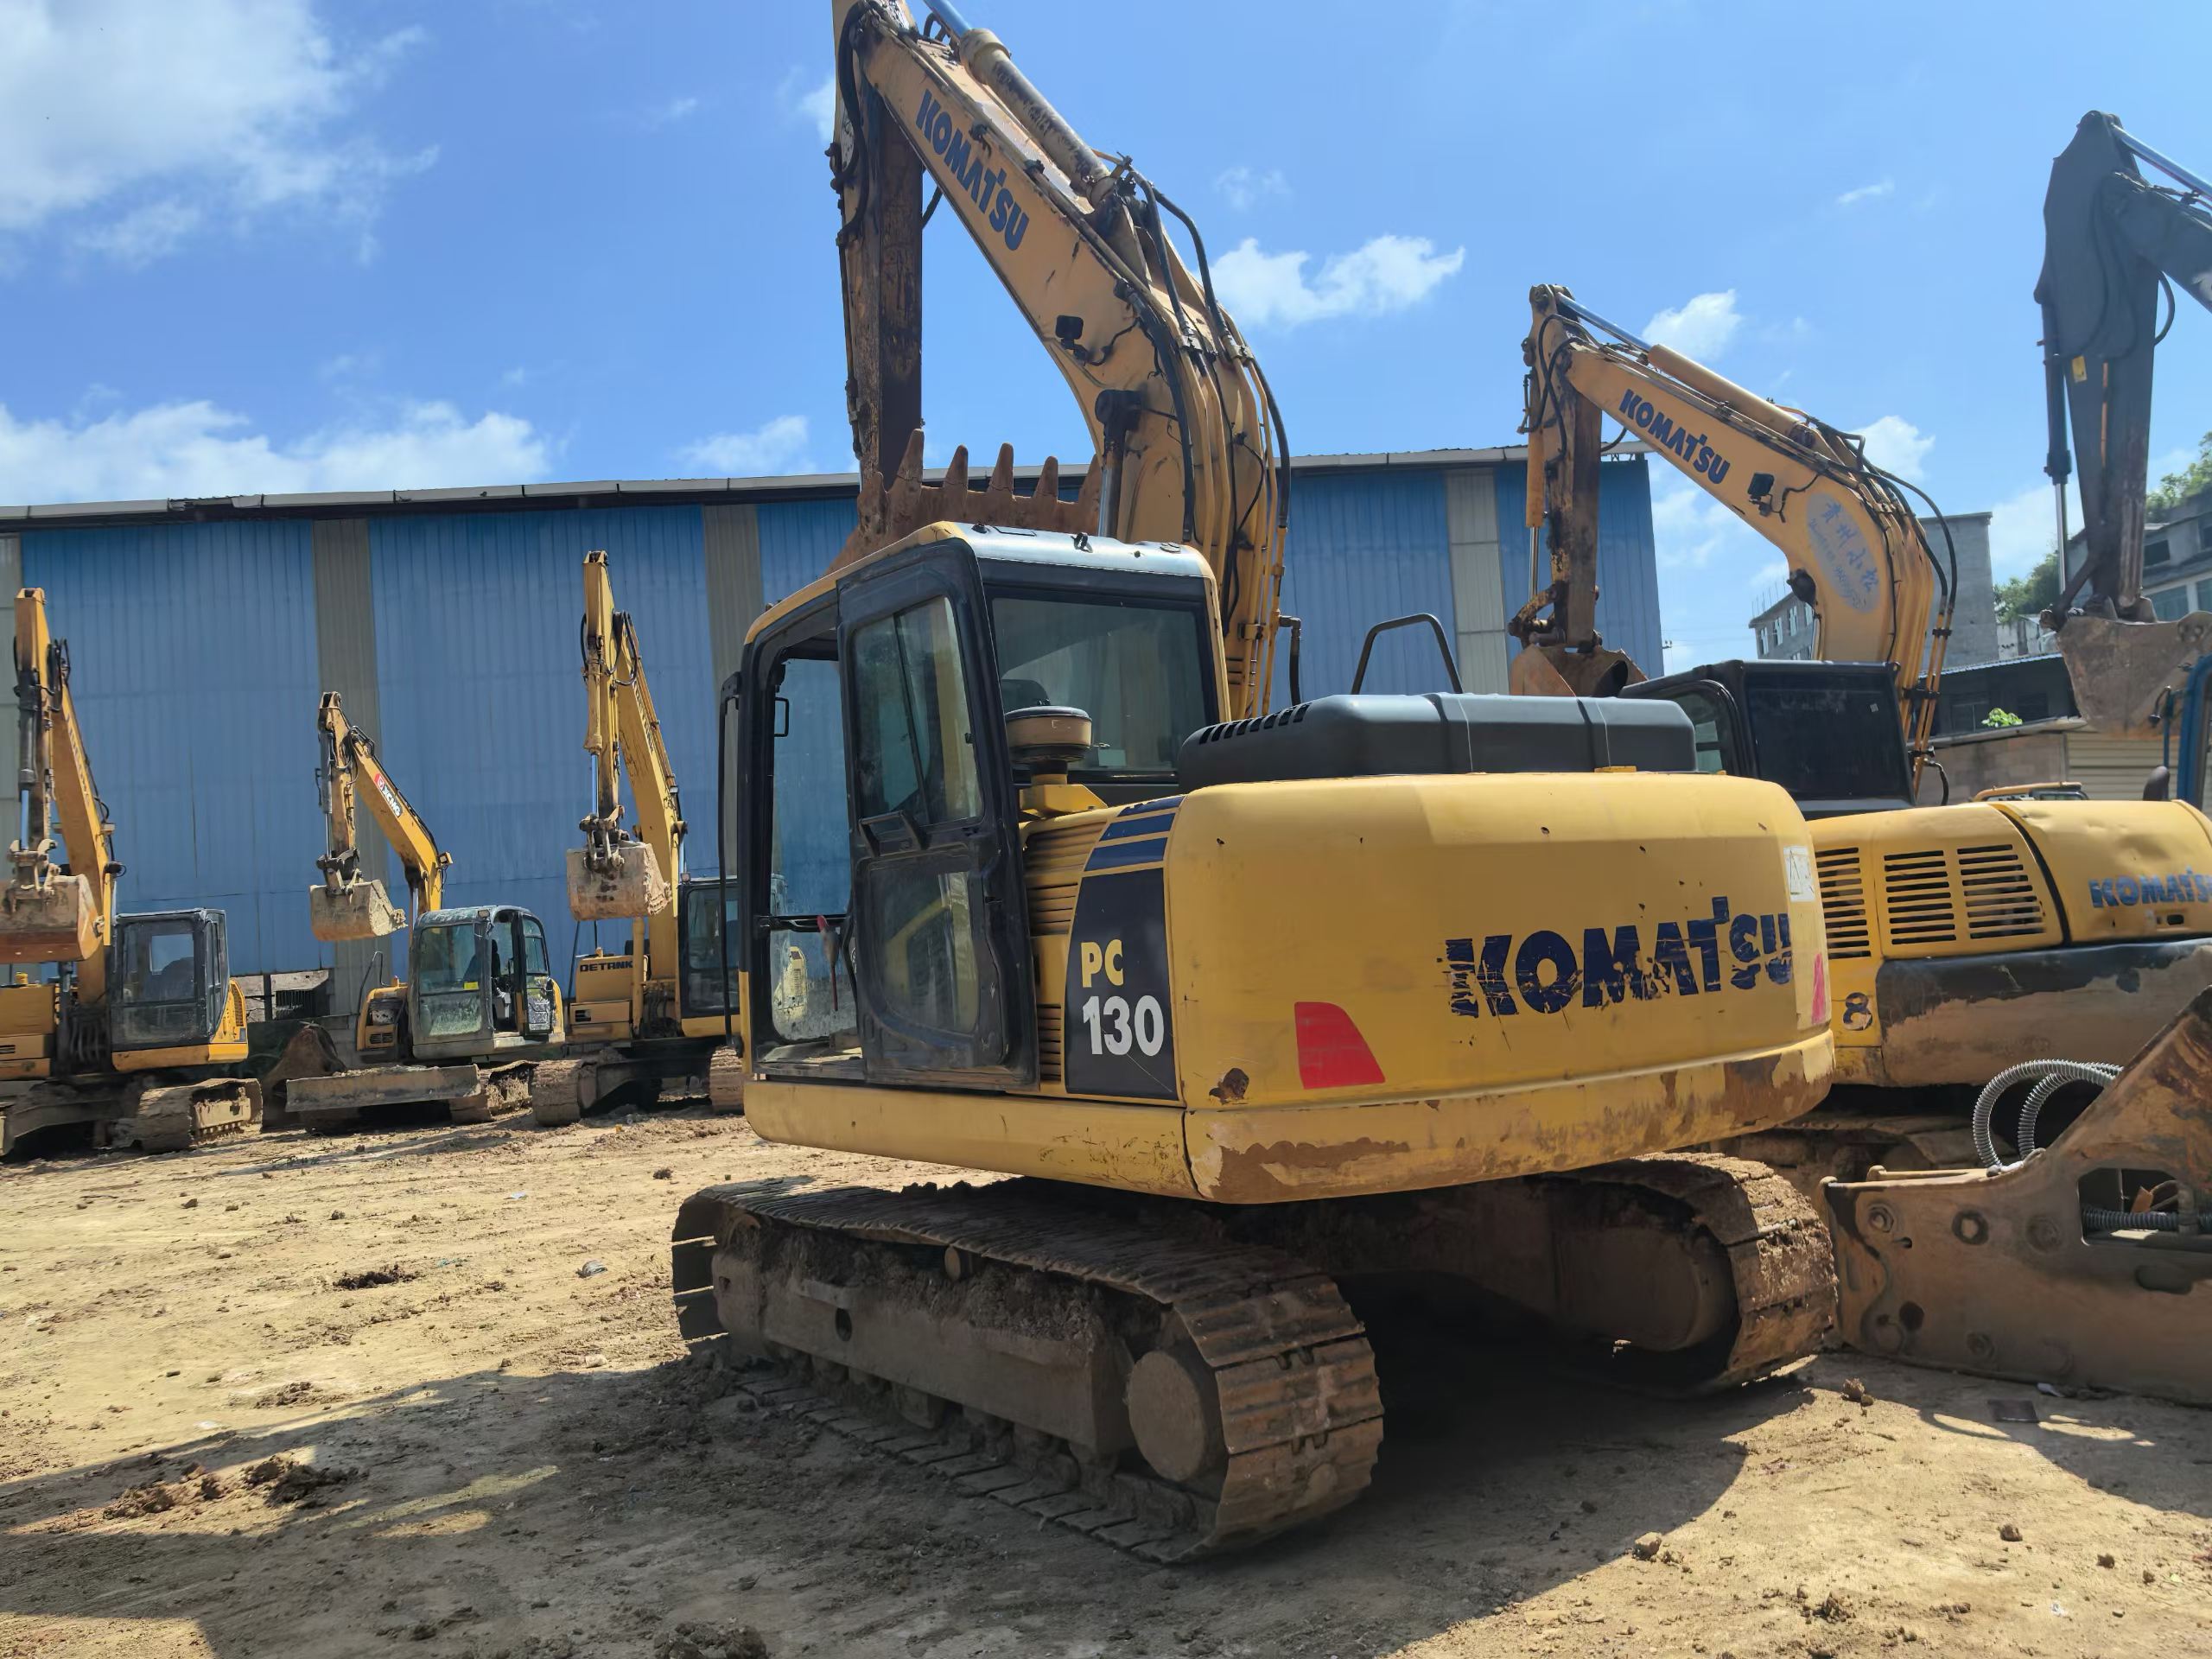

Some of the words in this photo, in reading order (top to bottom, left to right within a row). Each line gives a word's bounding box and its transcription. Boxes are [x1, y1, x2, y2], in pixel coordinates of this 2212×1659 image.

[916, 88, 1029, 251] KOMATSU
[1618, 389, 1731, 485] KOMATSU
[1081, 938, 1124, 988] PC
[1445, 896, 1793, 1018] KOMATSU
[1083, 995, 1165, 1057] 130
